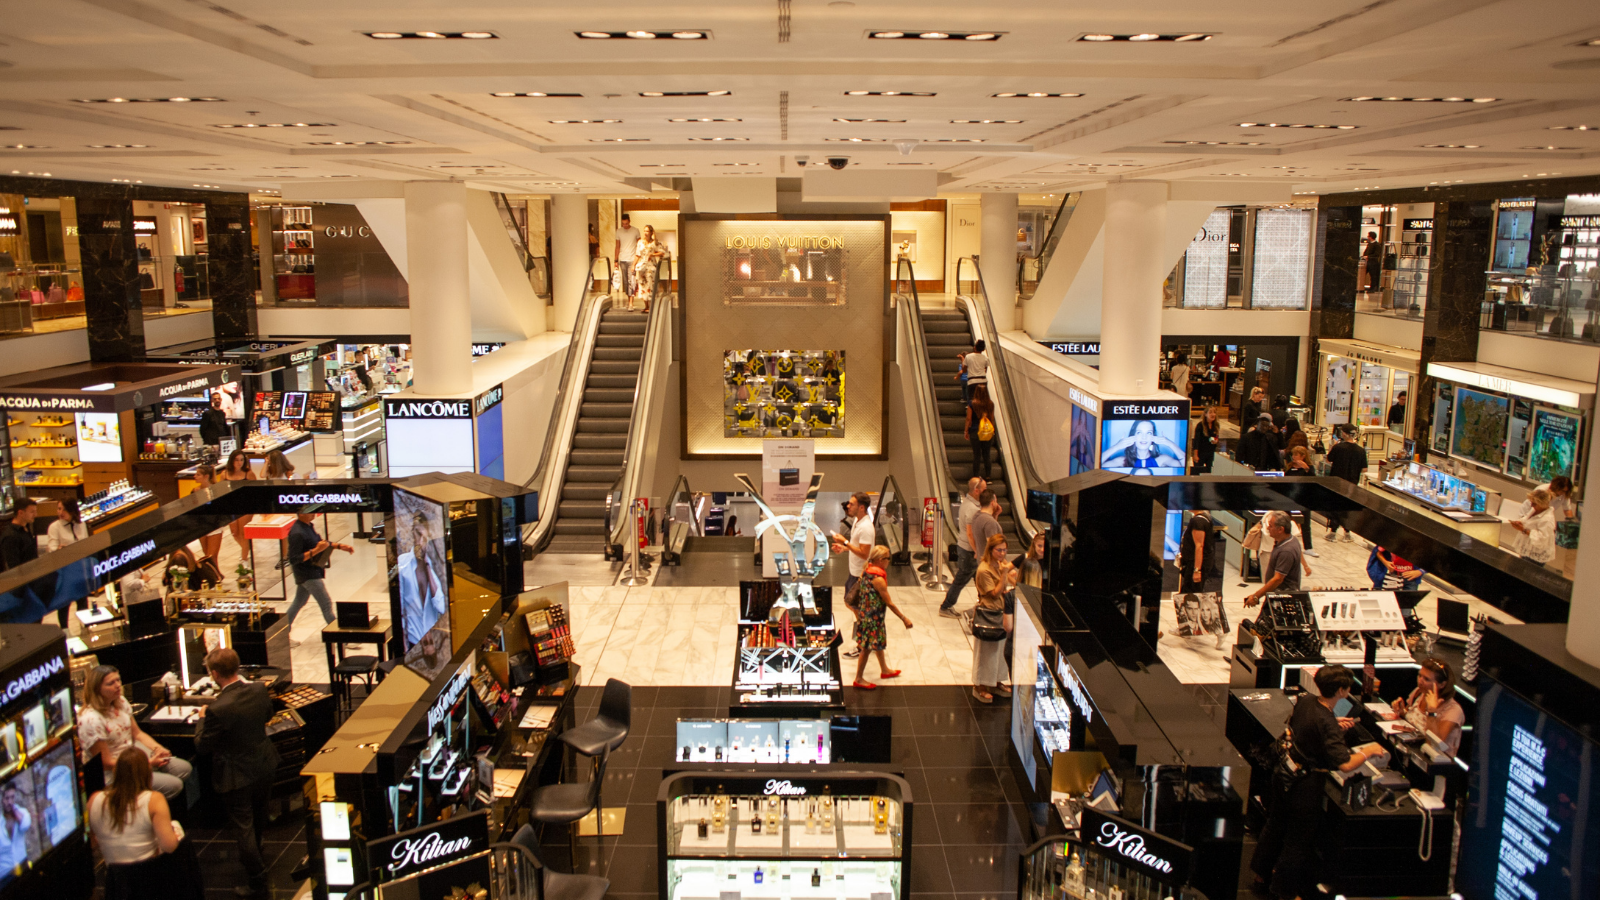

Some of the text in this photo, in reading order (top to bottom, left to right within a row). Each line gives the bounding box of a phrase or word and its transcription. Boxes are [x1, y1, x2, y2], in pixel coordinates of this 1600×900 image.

[959, 218, 976, 227] Dior
[725, 235, 846, 249] LOUIS VUITTON
[160, 384, 183, 397] ACQUA
[187, 377, 210, 390] PARMA
[0, 397, 41, 409] ACQUA
[51, 398, 95, 409] PARMA
[387, 401, 470, 417] LANCÔME
[1142, 406, 1179, 415] LAUDER
[763, 778, 807, 796] Kilian
[387, 831, 473, 872] Kilian
[1096, 821, 1174, 873] Kilian
